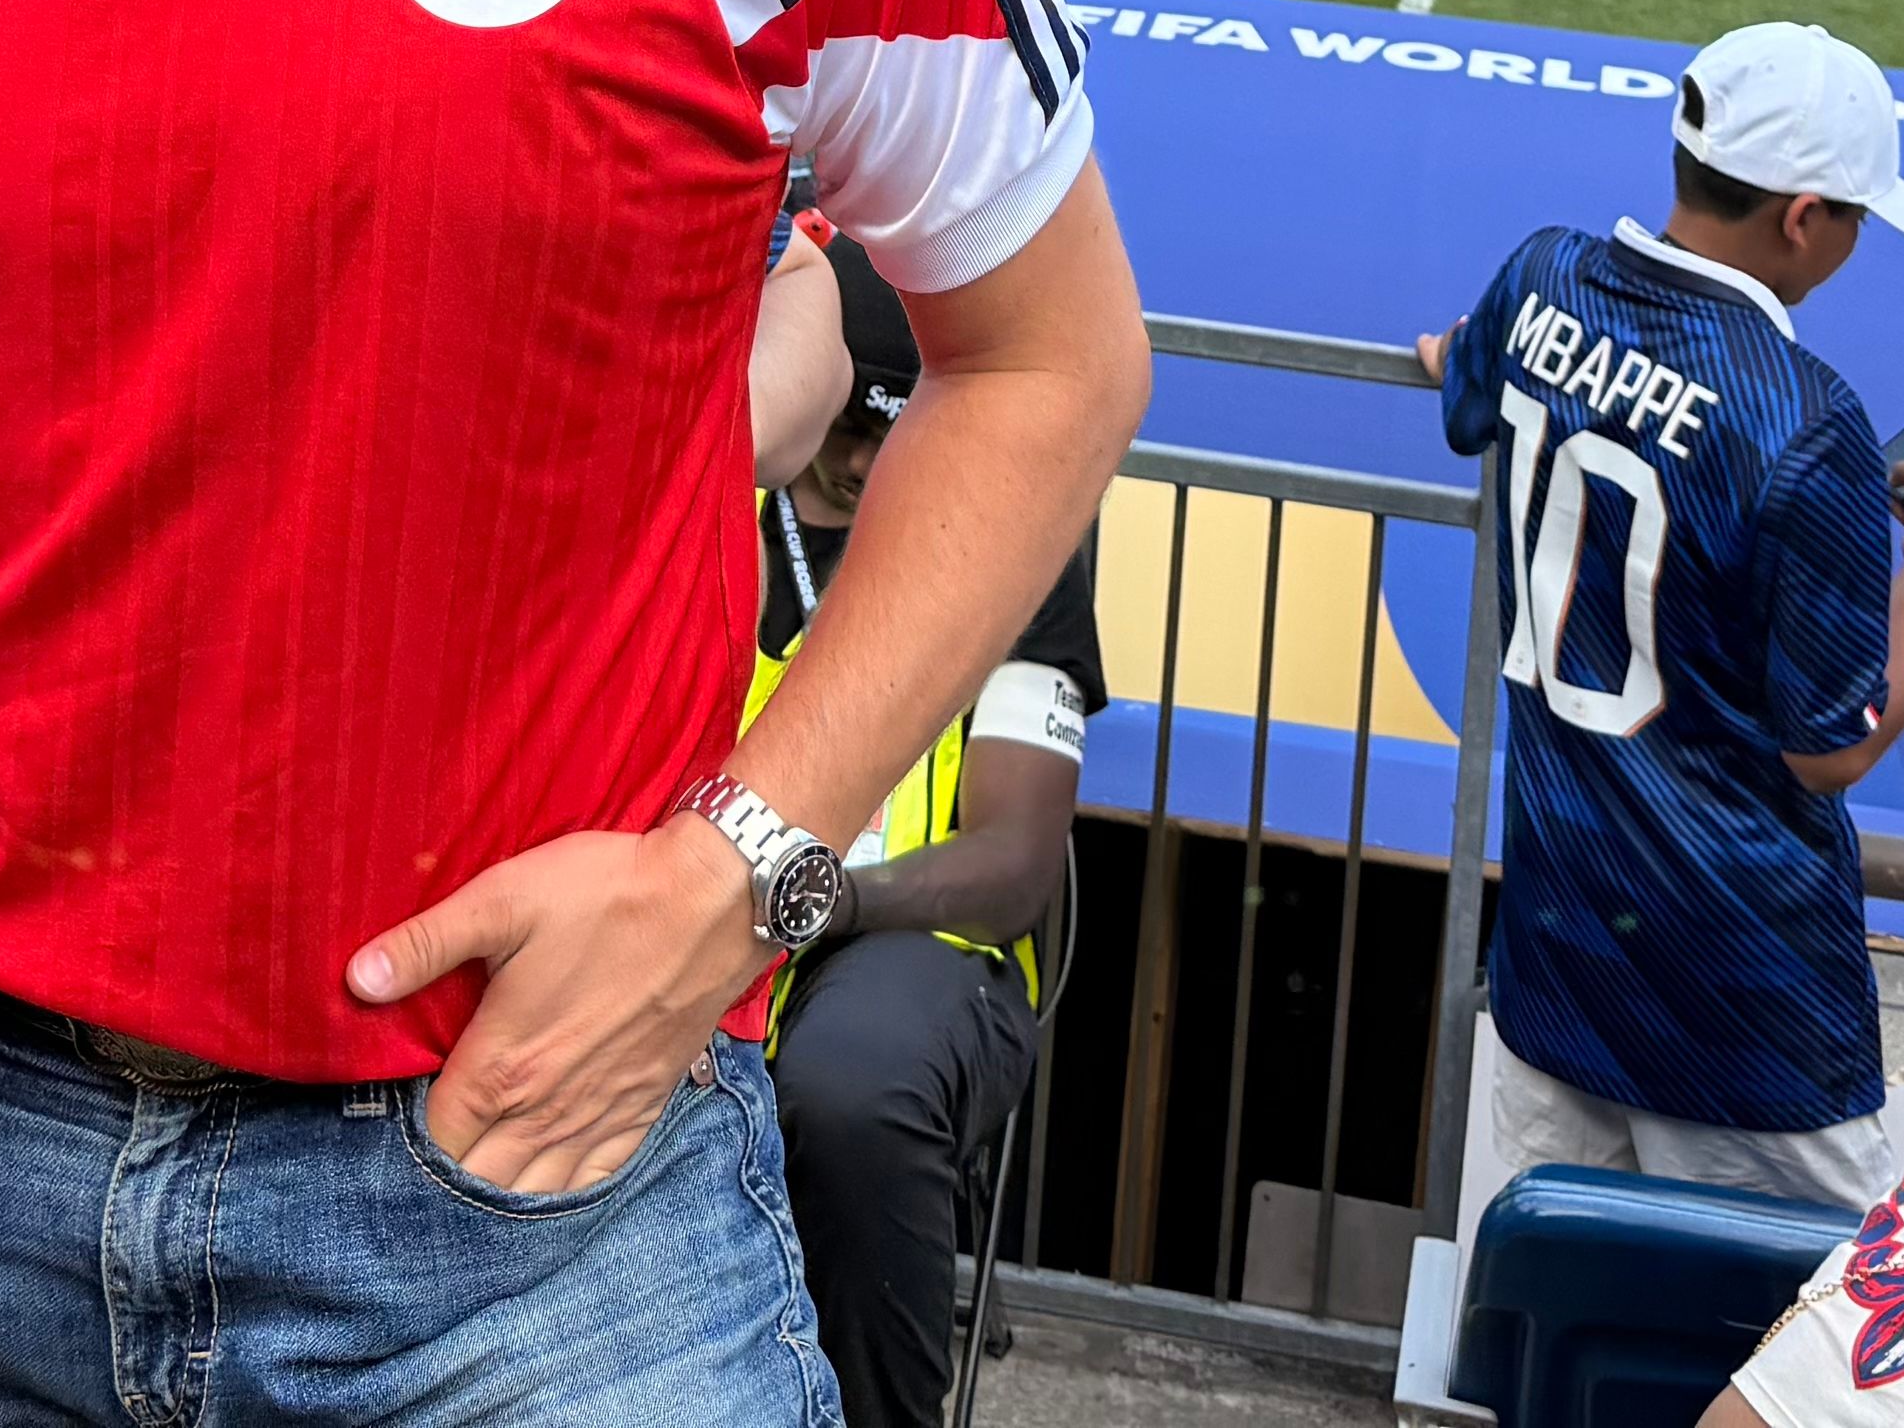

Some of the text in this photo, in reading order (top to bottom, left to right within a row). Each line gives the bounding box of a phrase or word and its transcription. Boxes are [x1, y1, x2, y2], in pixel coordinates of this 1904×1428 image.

[1065, 4, 1270, 52] FIFA
[1290, 27, 1676, 98] WORLD
[865, 384, 908, 421] Sup
[1505, 291, 1720, 460] MBAPPE
[1499, 380, 1670, 738] 10
